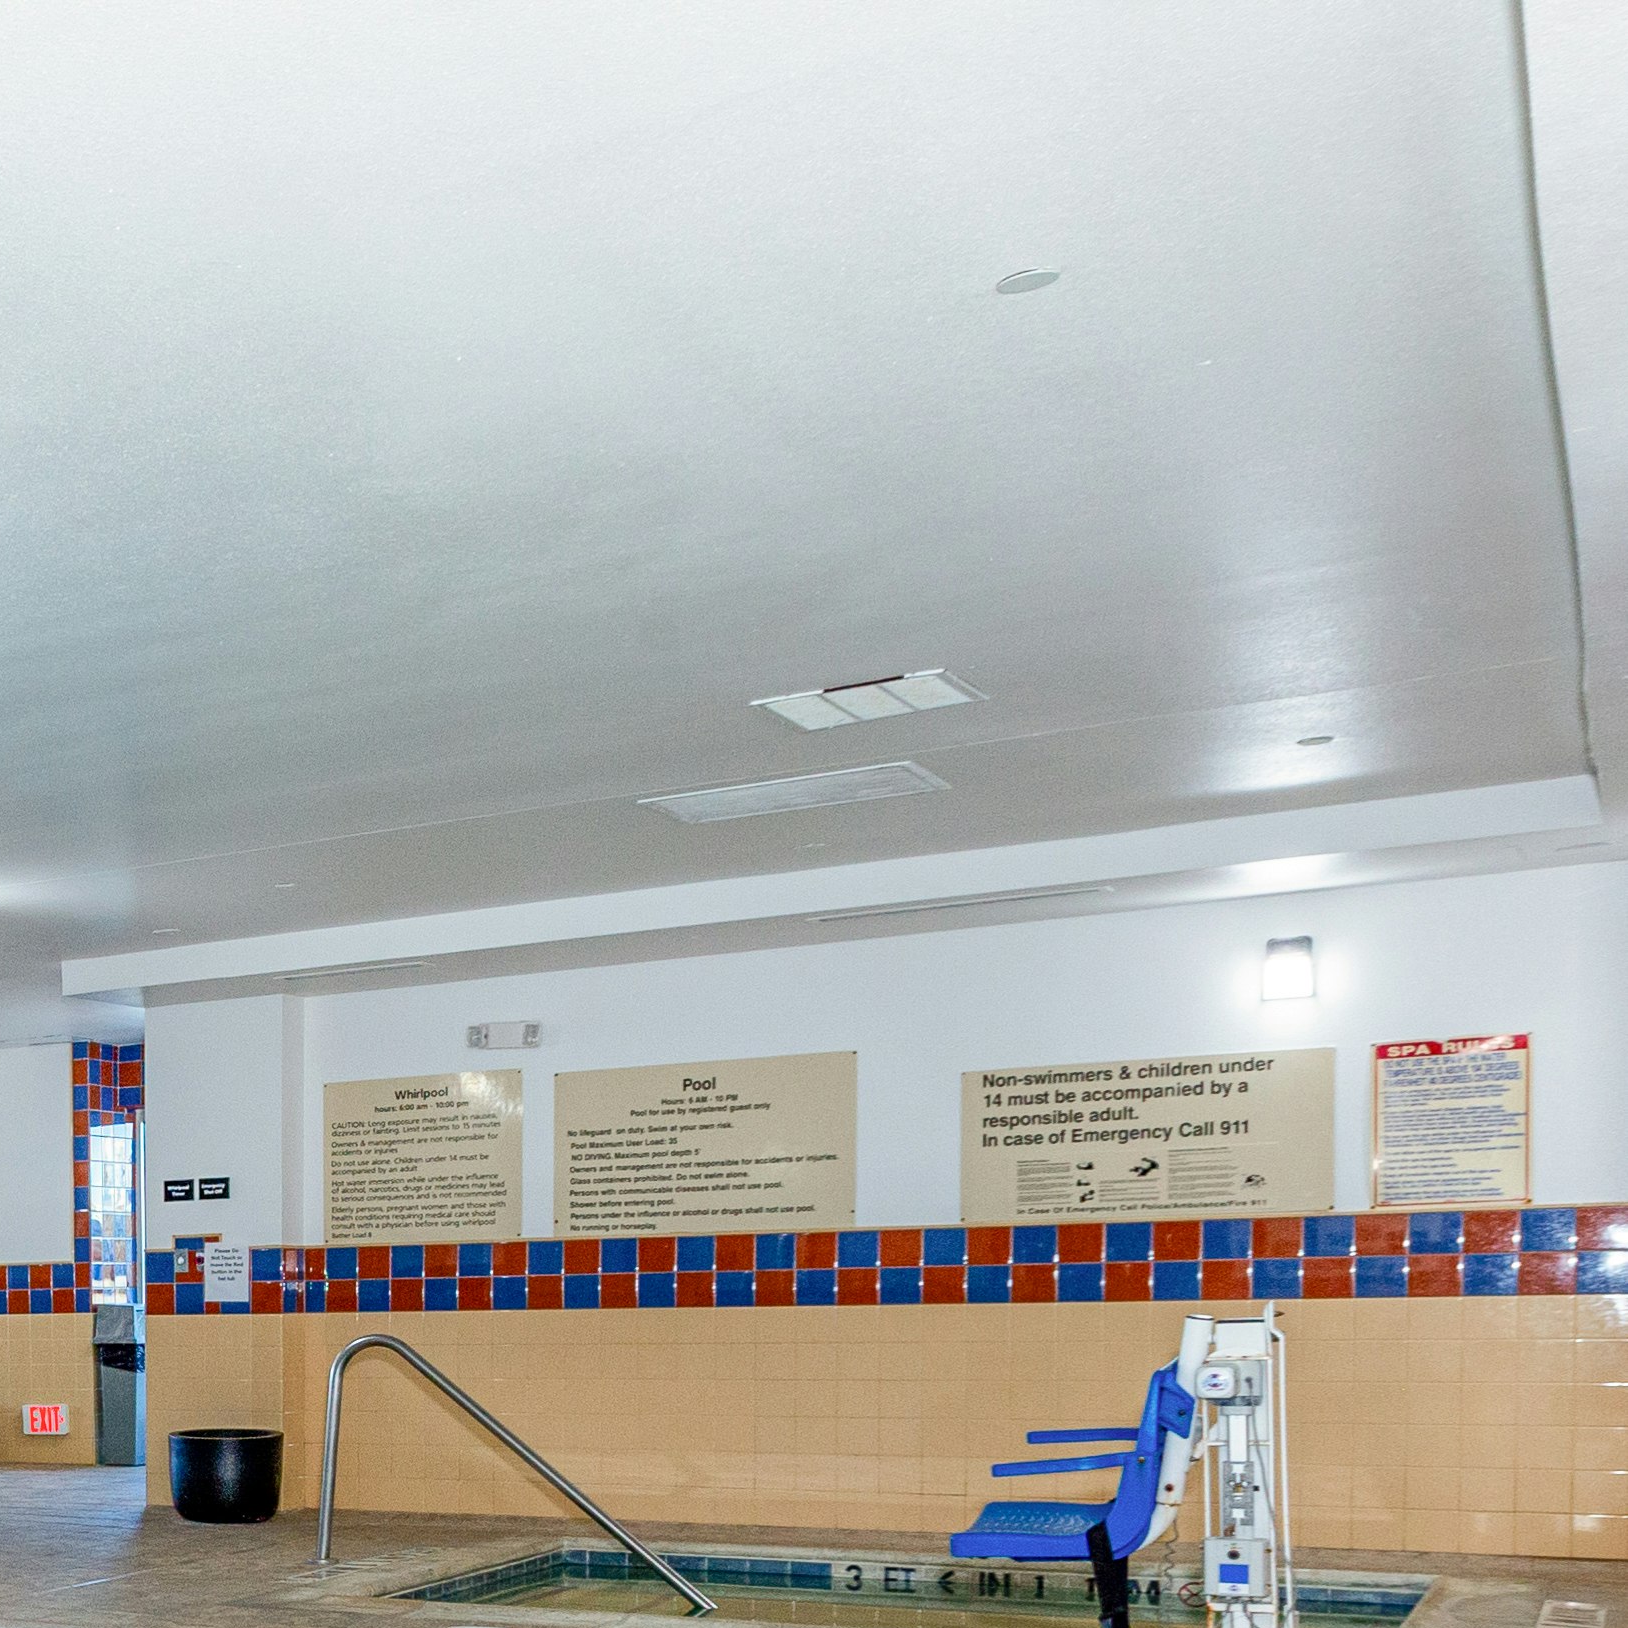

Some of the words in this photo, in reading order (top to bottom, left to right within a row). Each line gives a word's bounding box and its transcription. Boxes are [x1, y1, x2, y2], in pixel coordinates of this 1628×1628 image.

[1387, 1044, 1431, 1057] SPA
[1442, 1038, 1515, 1054] RULS
[683, 1077, 716, 1091] Pool
[983, 1067, 1112, 1088] Non-swimmers
[1137, 1060, 1211, 1078] children
[1219, 1056, 1273, 1073] under
[394, 1087, 448, 1101] Whirlpool
[984, 1094, 1002, 1107] 14
[1008, 1091, 1049, 1106] must
[1055, 1089, 1075, 1103] be
[1081, 1081, 1204, 1105] accompanied
[1210, 1079, 1231, 1097] by
[1238, 1082, 1247, 1092] a
[983, 1109, 1083, 1131] responsible
[1089, 1105, 1138, 1121] adult.
[983, 1133, 997, 1147] In
[1003, 1134, 1043, 1146] case
[1049, 1130, 1065, 1143] of
[1072, 1124, 1172, 1146] Emergency
[1179, 1122, 1213, 1137] Call
[1220, 1120, 1248, 1134] 911
[30, 1406, 60, 1432] EXIT
